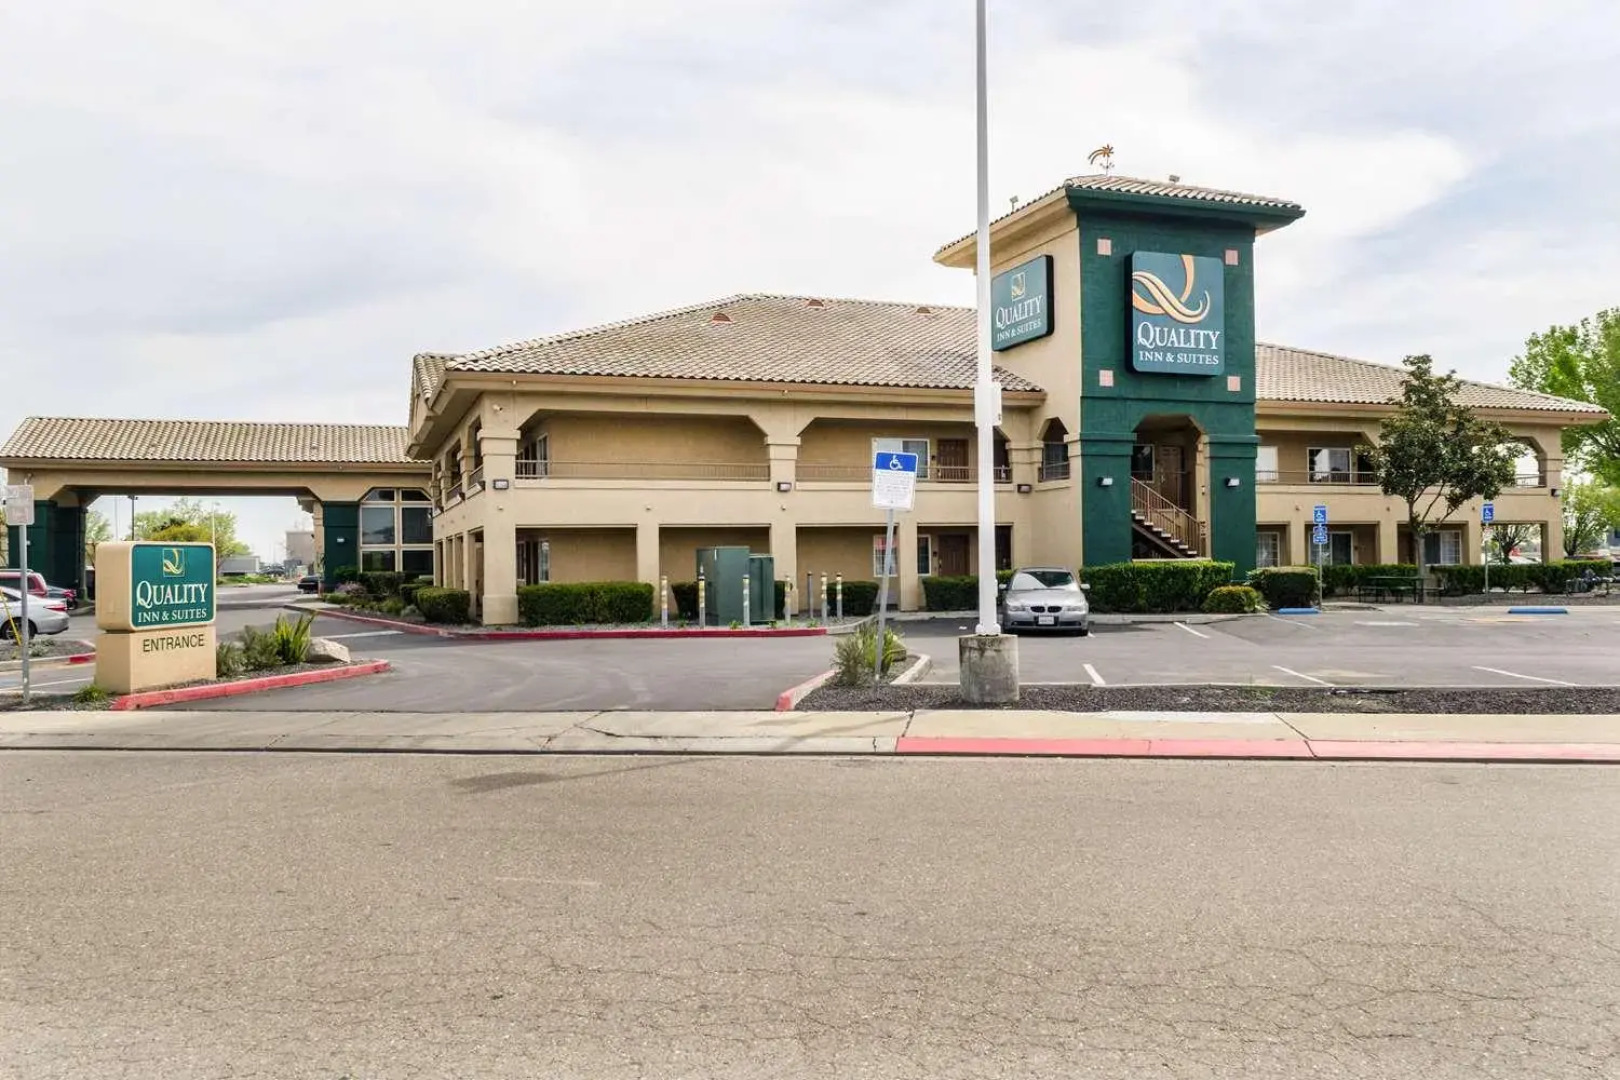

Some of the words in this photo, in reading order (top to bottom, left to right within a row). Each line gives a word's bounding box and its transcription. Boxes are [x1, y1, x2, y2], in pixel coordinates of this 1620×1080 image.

[996, 295, 1042, 329] QUALITY
[997, 329, 1010, 342] INN
[1017, 318, 1041, 335] SUITES
[1137, 321, 1220, 350] QUALITY
[1139, 351, 1163, 362] INN
[1165, 352, 1174, 363] &
[1177, 352, 1219, 365] SUITES
[136, 580, 208, 609] QUALITY
[138, 611, 160, 623] INN
[162, 611, 170, 621] &
[172, 608, 207, 620] SUITES
[143, 634, 205, 653] ENTRANCE
